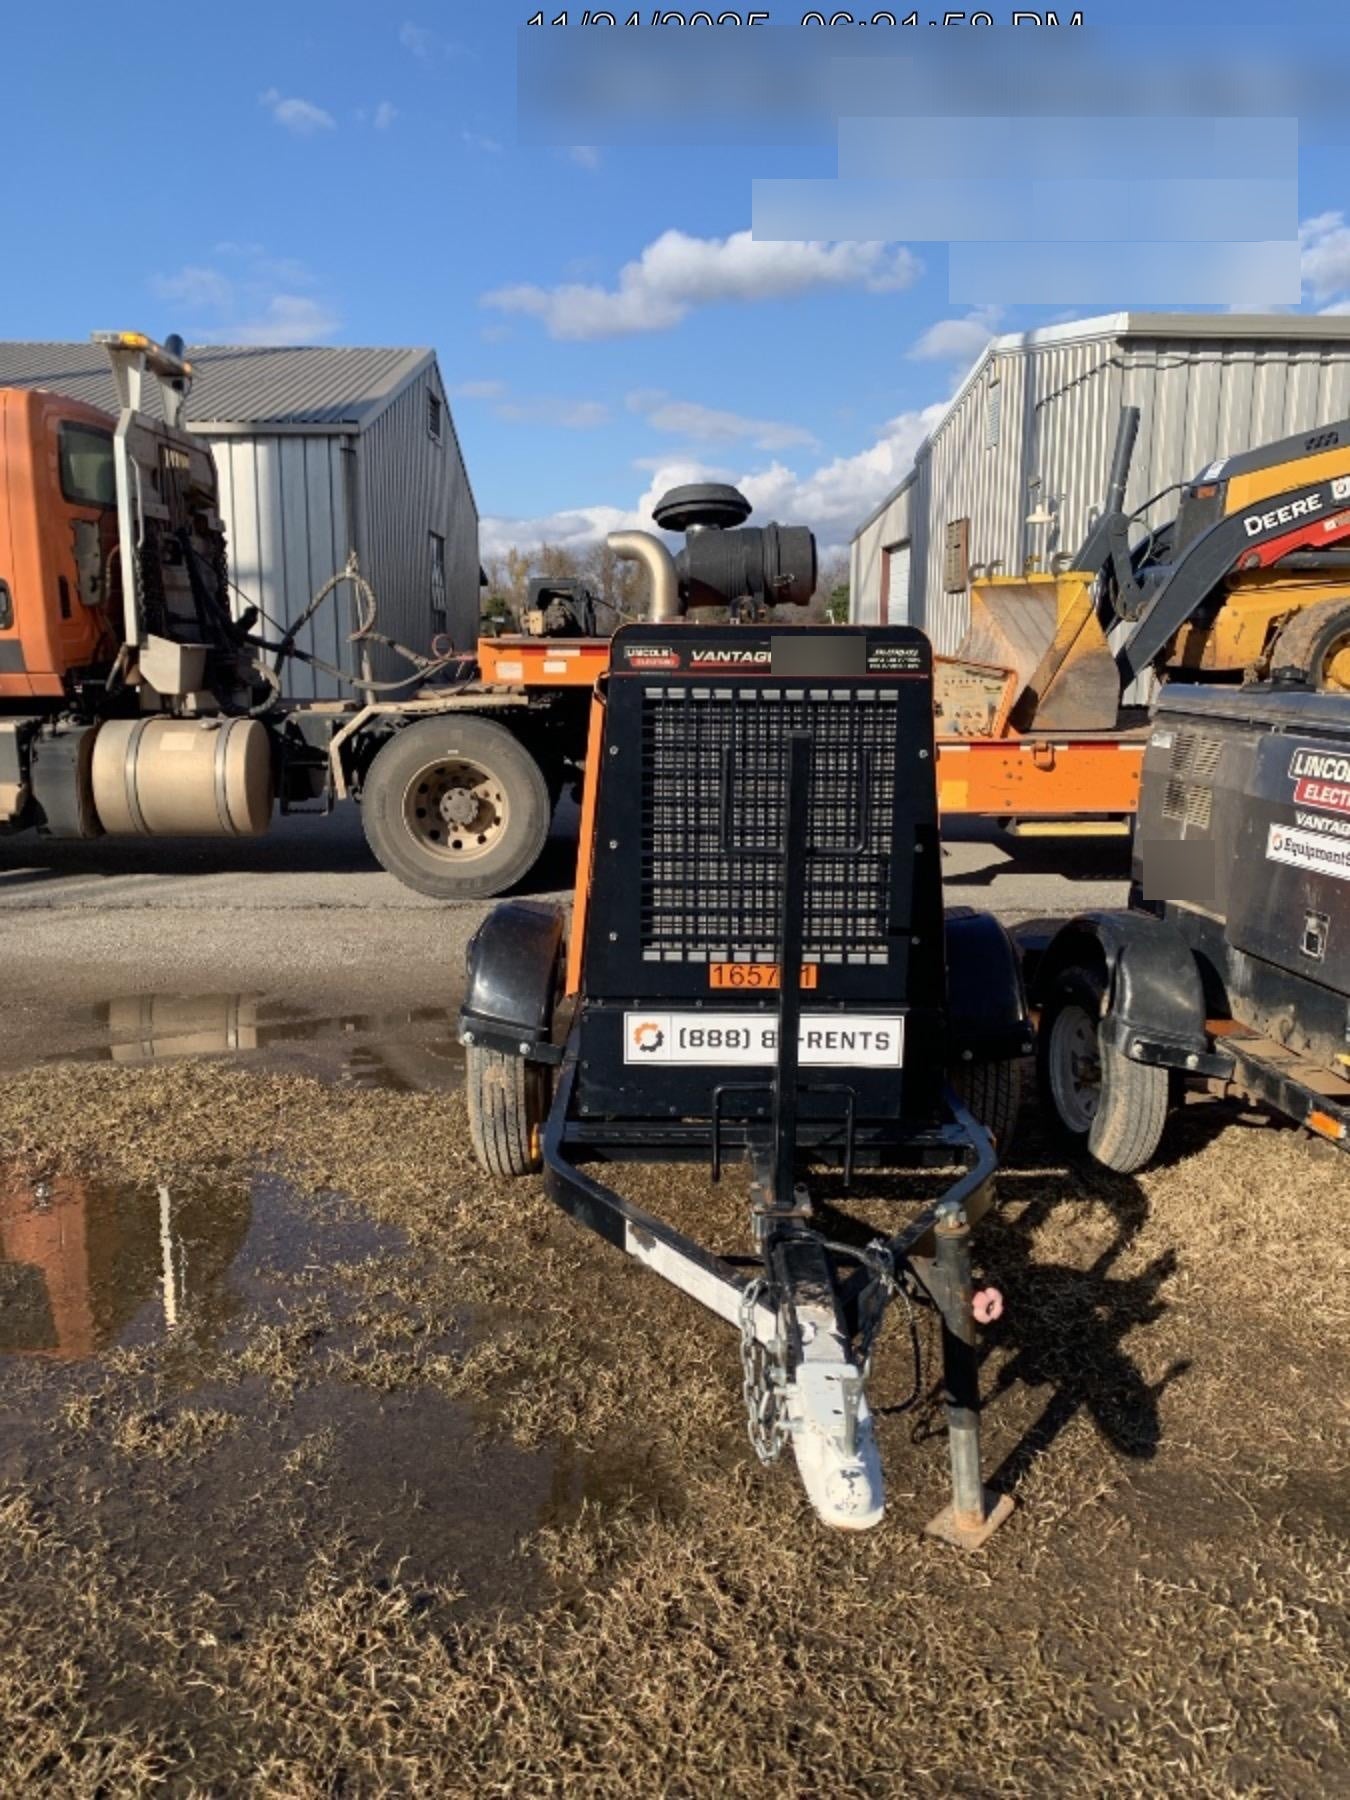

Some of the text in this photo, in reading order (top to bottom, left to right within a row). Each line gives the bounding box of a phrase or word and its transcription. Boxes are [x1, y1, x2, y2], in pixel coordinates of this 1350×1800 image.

[1243, 493, 1323, 537] DEERE
[691, 650, 771, 663] VANTAG
[713, 965, 810, 986] 16571
[678, 1028, 890, 1050] (888) 8-RENTS
